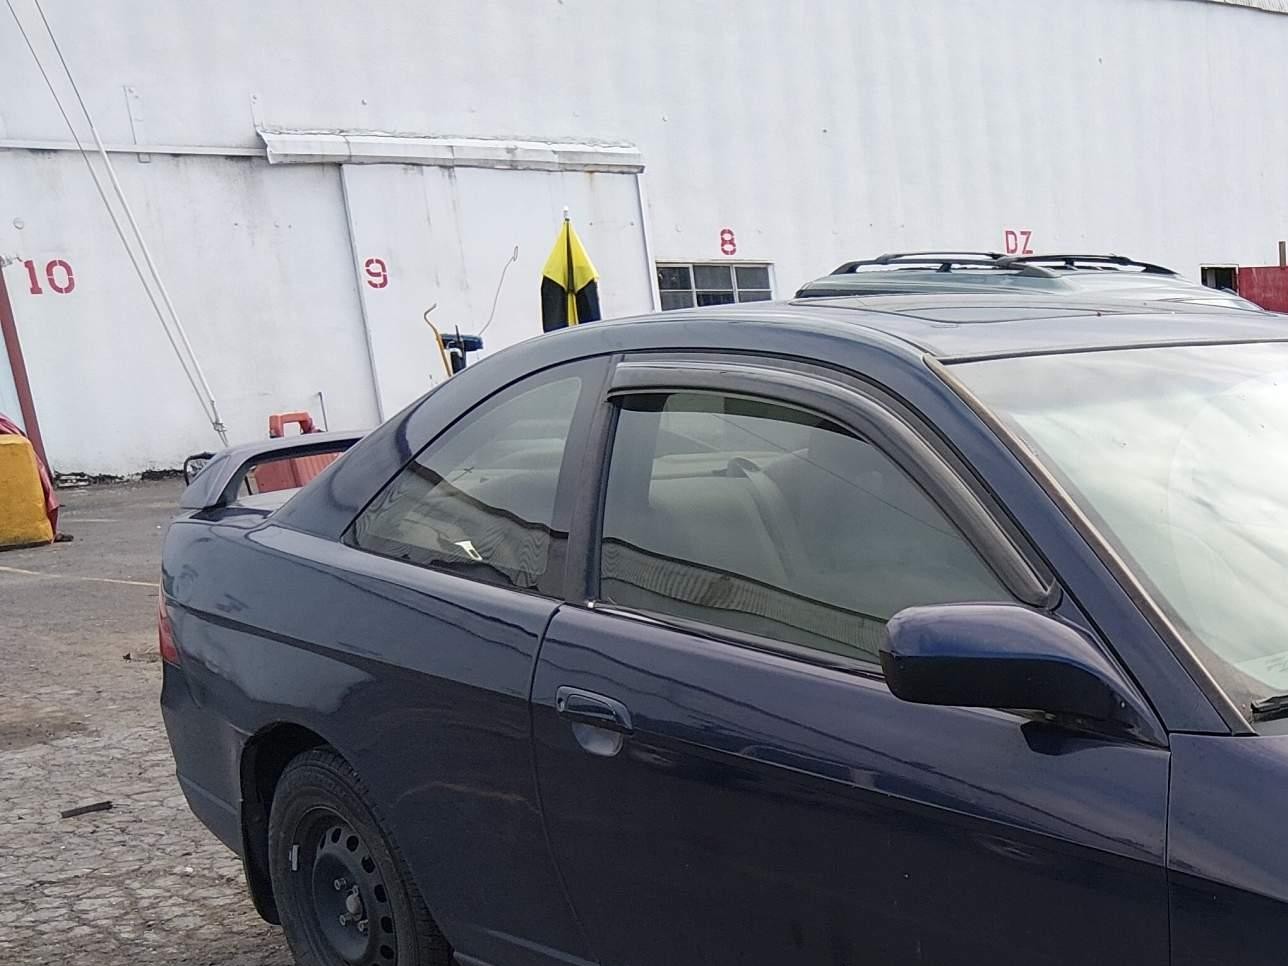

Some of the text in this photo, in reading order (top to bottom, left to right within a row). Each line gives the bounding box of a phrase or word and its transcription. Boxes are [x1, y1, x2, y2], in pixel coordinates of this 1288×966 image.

[719, 228, 737, 256] 8
[1005, 230, 1034, 255] DZ
[24, 259, 75, 295] 10
[365, 258, 389, 289] 9
